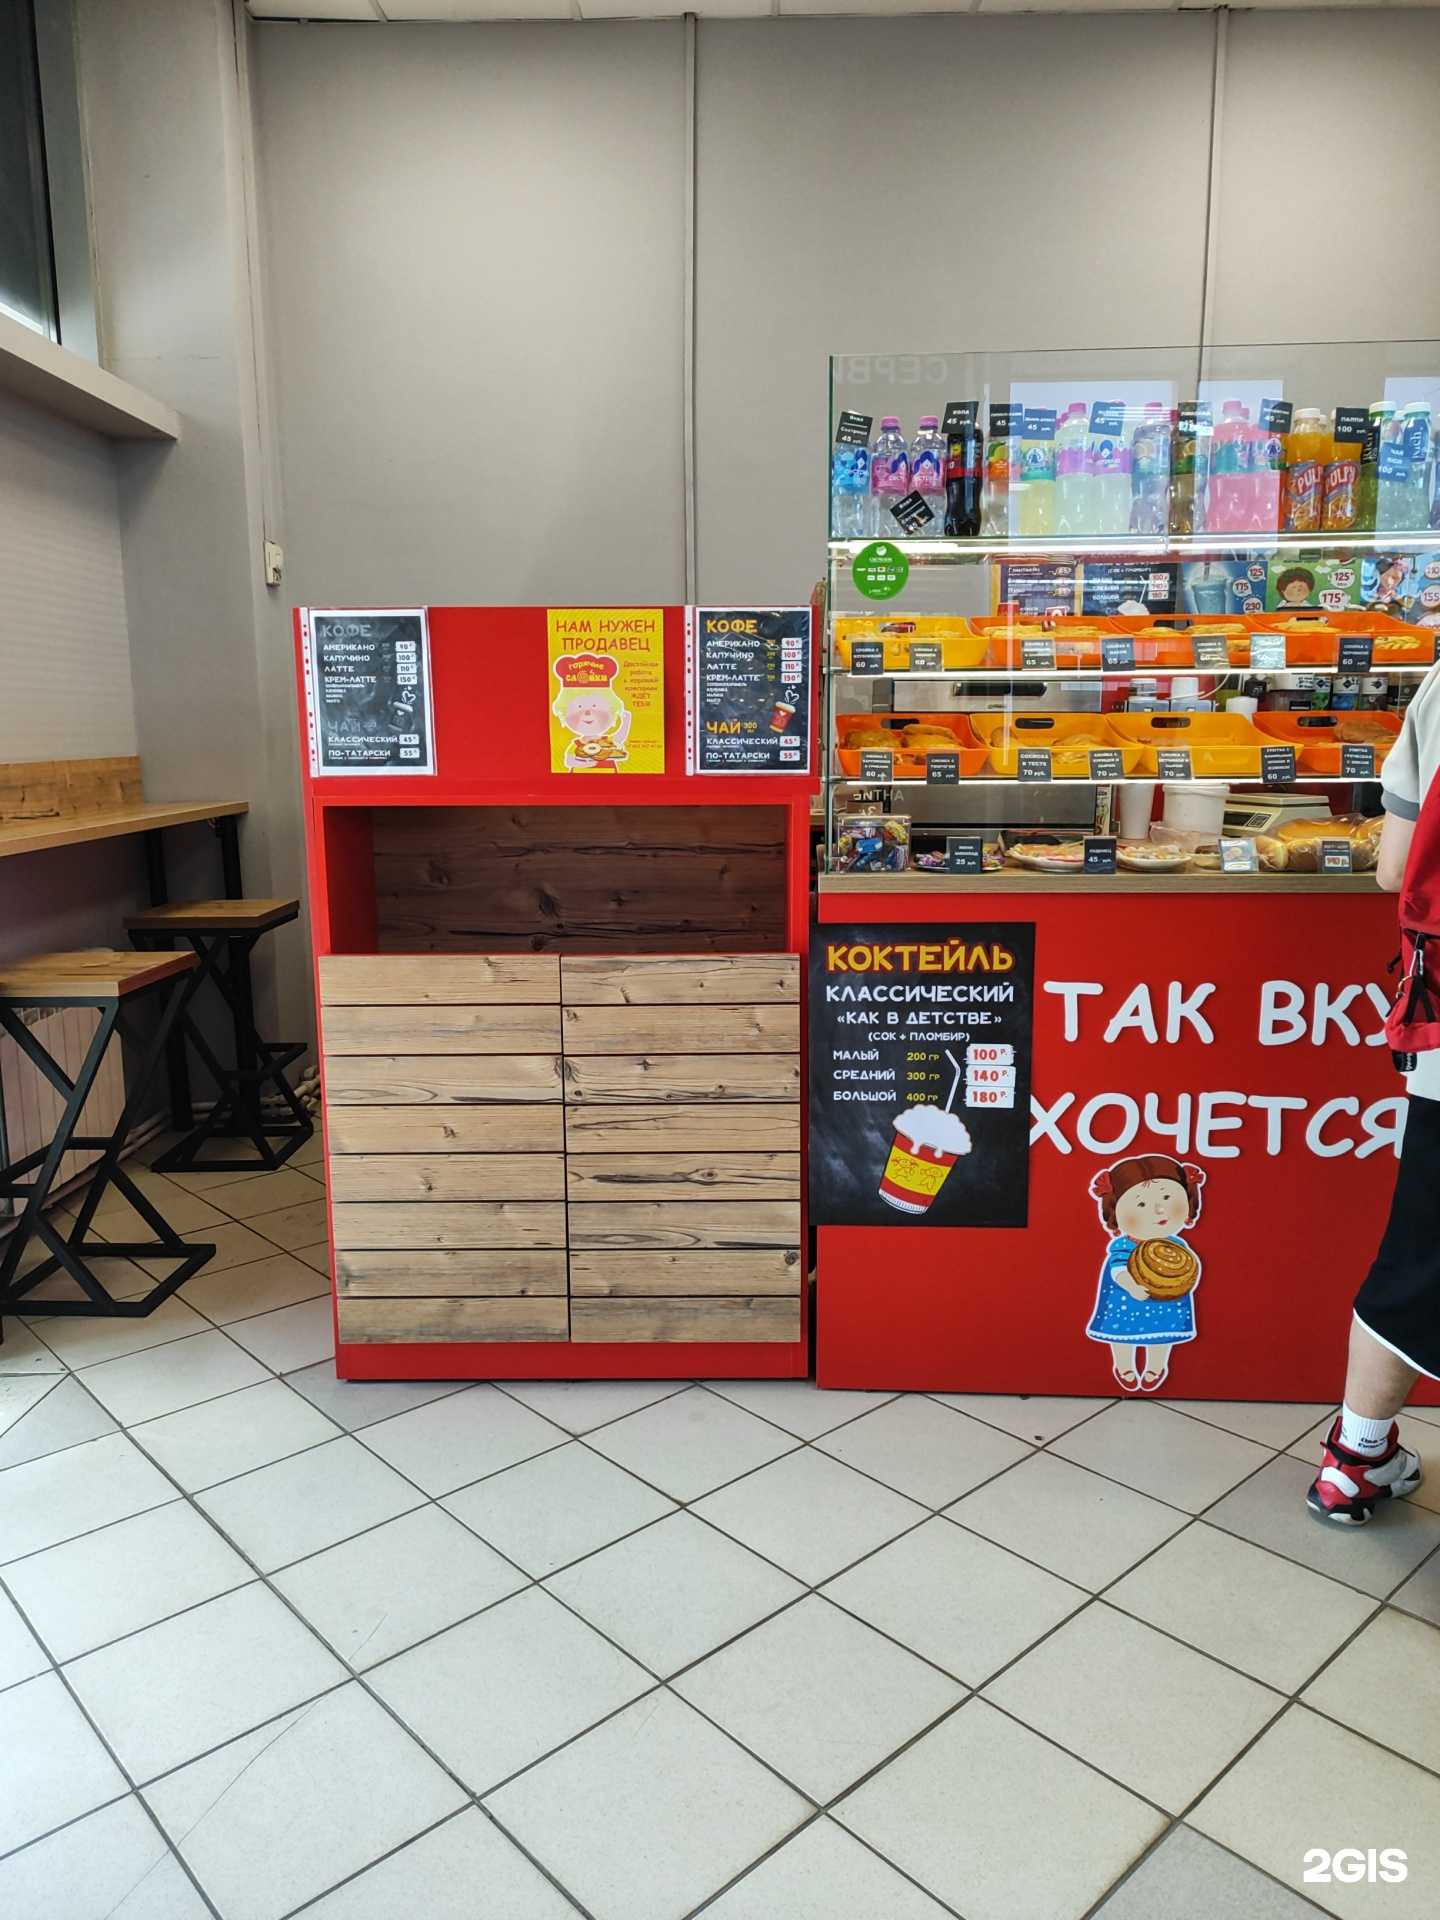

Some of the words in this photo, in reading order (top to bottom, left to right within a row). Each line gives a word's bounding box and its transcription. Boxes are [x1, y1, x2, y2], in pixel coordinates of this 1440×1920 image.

[1337, 425, 1352, 433] 100
[1249, 568, 1263, 576] 125
[1335, 572, 1350, 581] 125
[1235, 583, 1249, 591] 175
[1322, 592, 1341, 603] 175
[1245, 602, 1260, 610] 230
[322, 624, 372, 637] КОФЕ
[556, 620, 592, 633] НАМ
[599, 619, 656, 633] НУЖЕН
[706, 619, 758, 633] КОФЕ
[323, 643, 376, 651] АМЕРИКАНО
[561, 637, 650, 652] ПРОДАВЕЦ
[706, 640, 760, 648] АМЕРИКАНО
[323, 654, 371, 662] КАПУЧИНО
[706, 651, 754, 659] КАПУЧИНО
[324, 665, 355, 673] ЛАТТЕ
[324, 675, 377, 683] КРЕМ-ЛАТТЕ
[706, 674, 760, 682] КРЕМ-ЛАТТЕ
[327, 717, 361, 733] ЧАЙ
[706, 718, 741, 734] ЧАЙ
[328, 735, 398, 743] КЛАССИЧЕСКИЙ
[706, 736, 778, 745] КЛАССИЧЕСКИЙ
[328, 749, 391, 757] ПО-ТАТАРСКИ
[827, 939, 1015, 972] КОКТЕЙЛЬ
[826, 982, 1014, 1002] КЛАССИЧЕСКИЙ
[1043, 980, 1217, 1045] ТАК
[837, 1011, 880, 1025] «КАК
[886, 1011, 899, 1025] В
[905, 1011, 1002, 1025] ДЕТСТВЕ»
[868, 1032, 897, 1042] (СОК
[909, 1032, 971, 1042] ПЛОМБИР)
[833, 1049, 880, 1060] МАЛЫЙ
[906, 1052, 926, 1061] 200
[973, 1048, 998, 1060] 100
[833, 1068, 896, 1080] СРЕДНИЙ
[906, 1072, 926, 1081] 300
[973, 1070, 999, 1081] 140
[833, 1089, 897, 1101] БОЛЬШОЙ
[906, 1093, 926, 1101] 400
[972, 1091, 998, 1103] 180
[1030, 1091, 1410, 1159] ХОЧЕТСЯ
